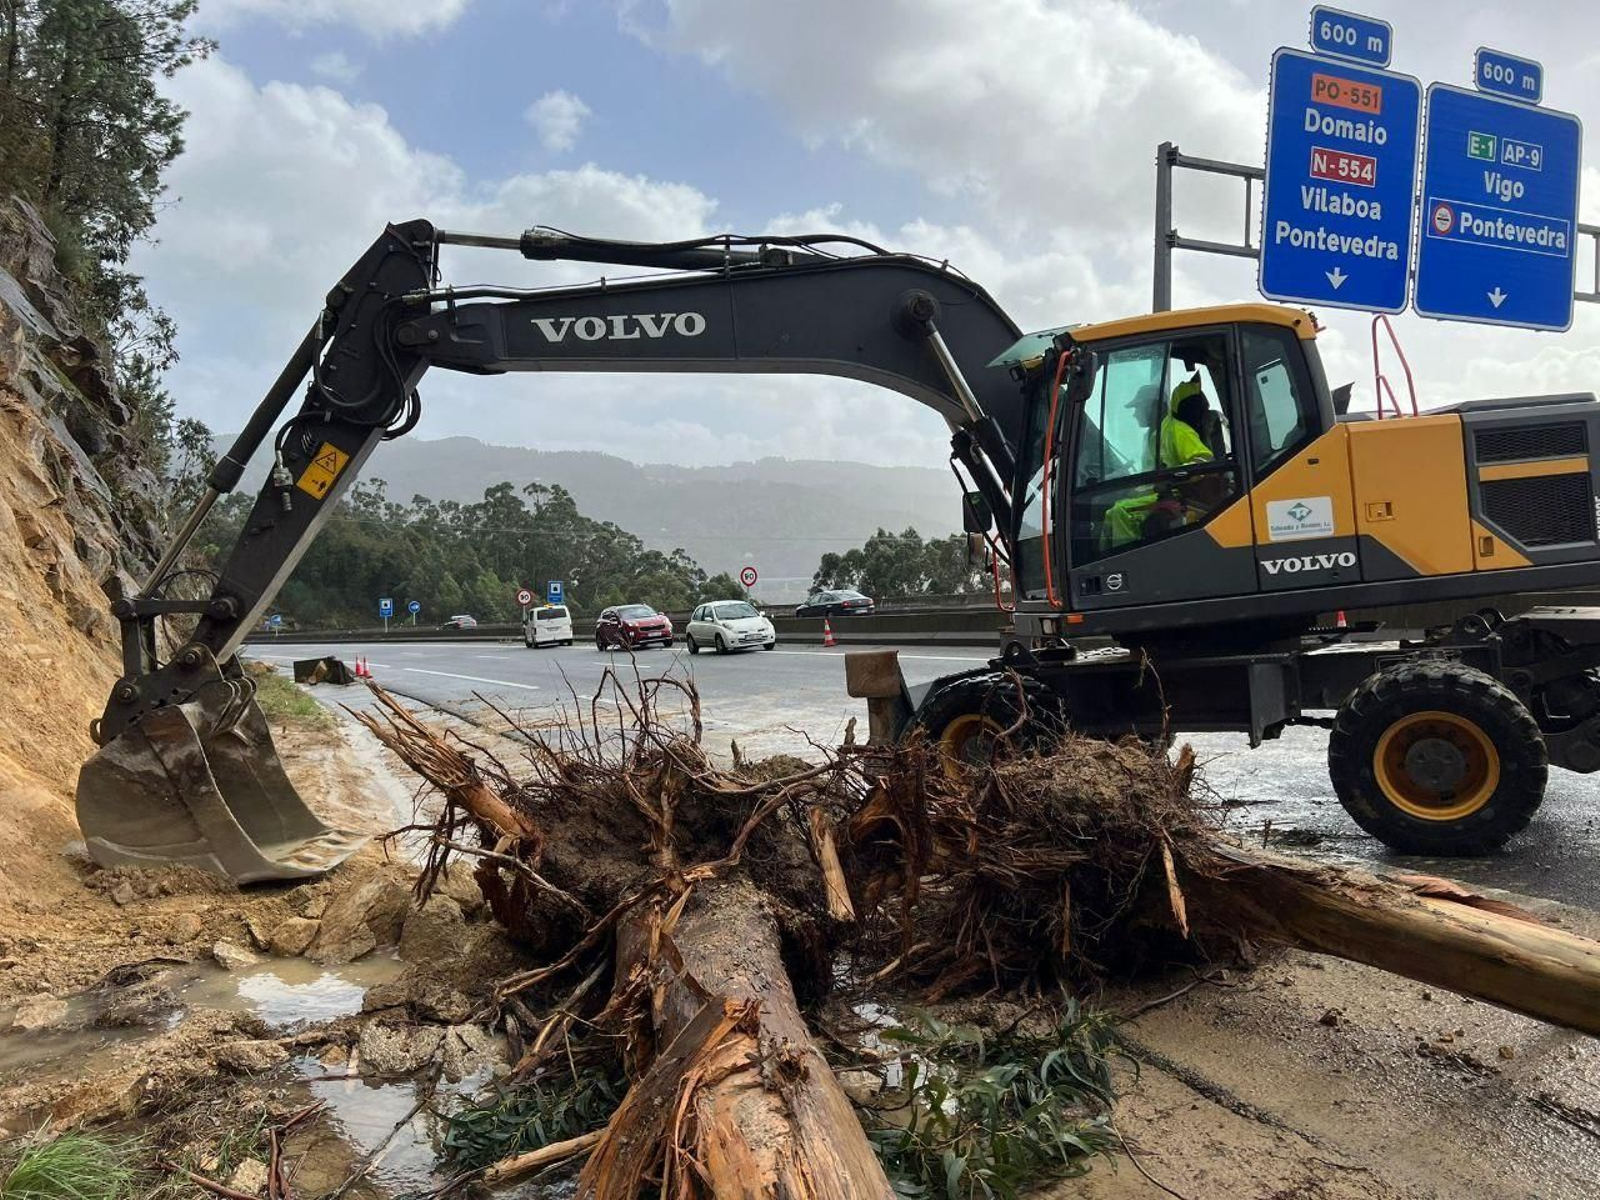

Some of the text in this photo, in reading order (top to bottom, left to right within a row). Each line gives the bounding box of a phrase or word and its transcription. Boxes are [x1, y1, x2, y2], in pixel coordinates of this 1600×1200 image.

[1320, 21, 1383, 53] 600 m
[1483, 62, 1535, 90] 600 m
[1315, 79, 1380, 109] PO-551
[1304, 107, 1387, 145] Domaio
[1470, 136, 1540, 166] E-1 AP-9
[1313, 153, 1373, 181] N-554
[1484, 170, 1525, 202] Vigo
[1301, 185, 1382, 220] Vilaboa
[1275, 220, 1398, 260] Pontevedra
[1460, 212, 1566, 249] Pontevedra
[530, 312, 706, 342] VOLVO
[1260, 552, 1356, 575] VOLVO
